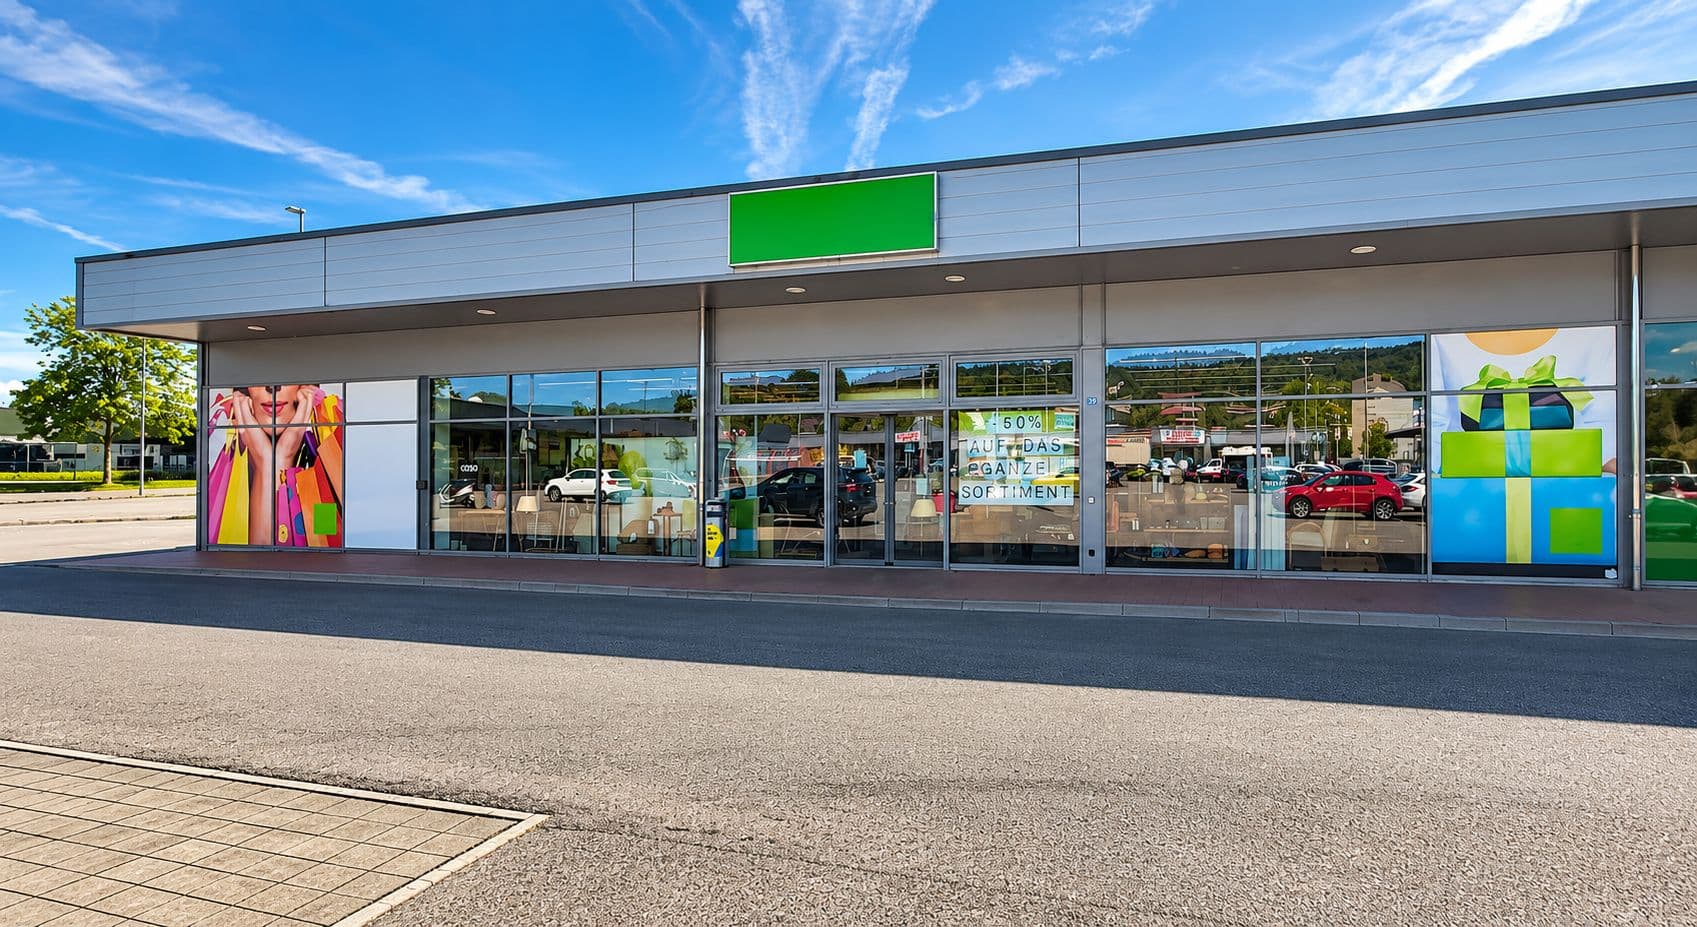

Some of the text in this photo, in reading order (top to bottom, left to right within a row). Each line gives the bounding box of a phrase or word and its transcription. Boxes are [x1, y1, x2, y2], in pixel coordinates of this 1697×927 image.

[969, 438, 1061, 453] AUF DAS
[961, 485, 1070, 498] SORTIMENT
